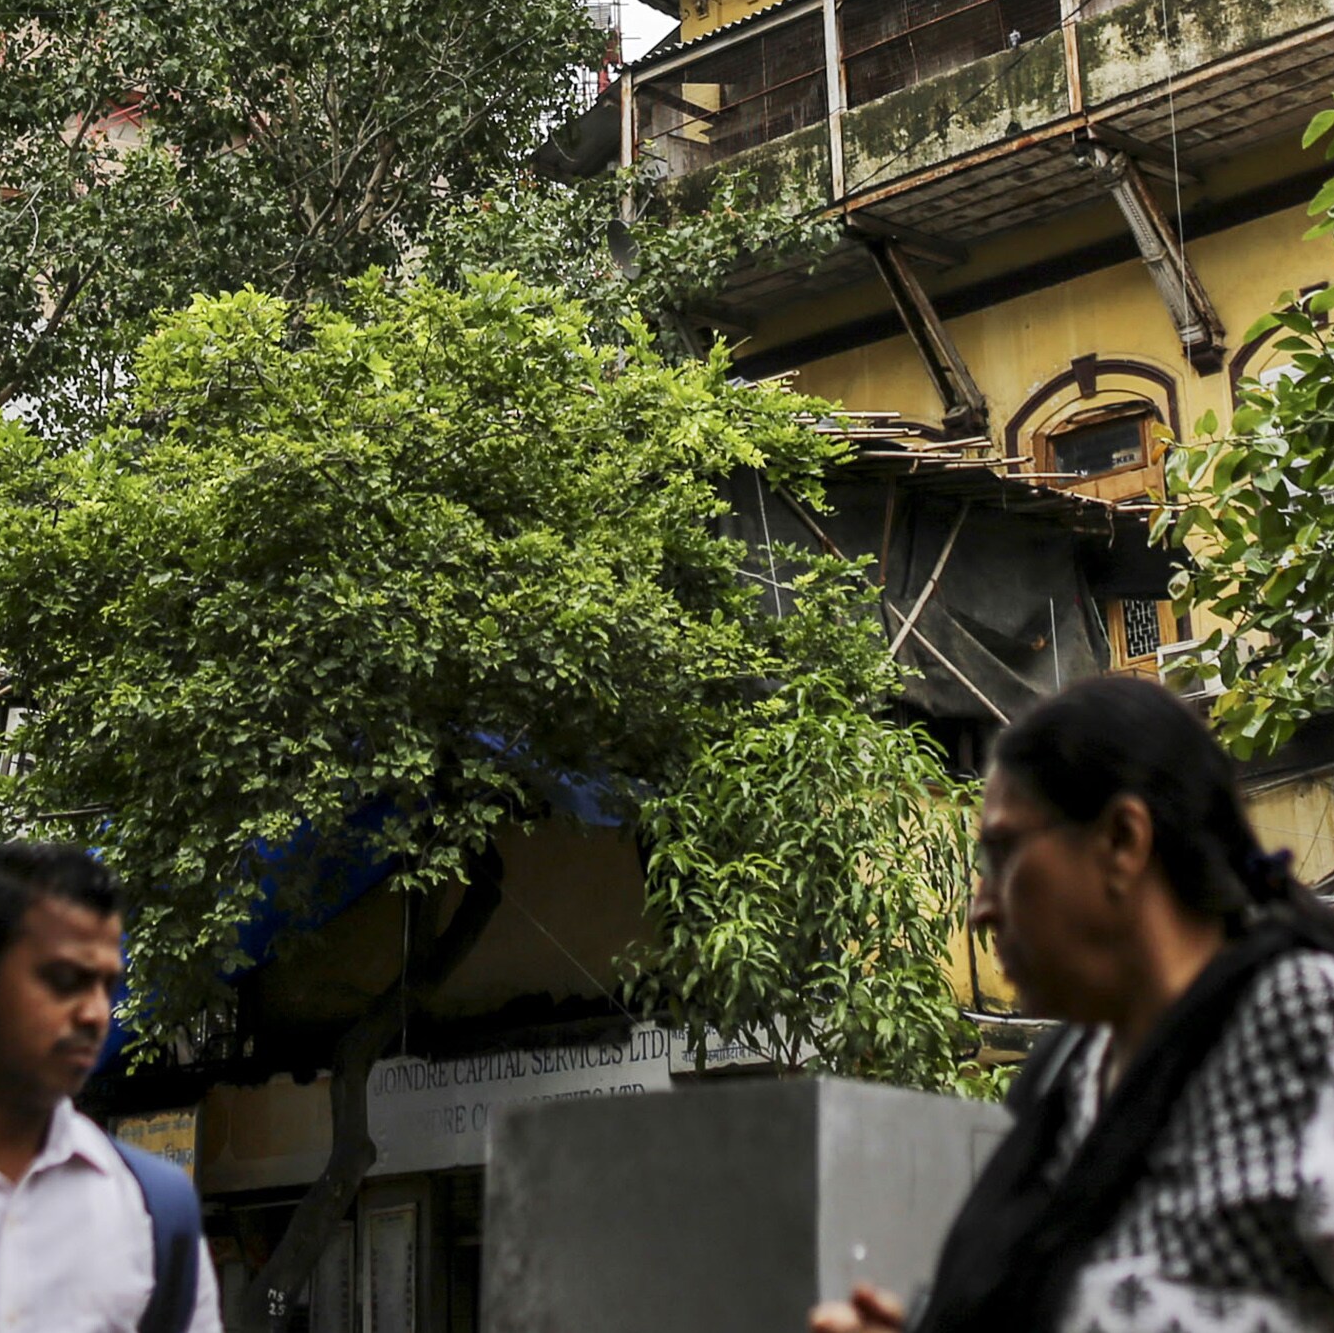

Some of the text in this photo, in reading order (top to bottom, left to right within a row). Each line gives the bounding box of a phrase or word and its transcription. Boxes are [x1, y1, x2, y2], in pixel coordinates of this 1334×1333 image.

[373, 1061, 449, 1097] JOINDRE
[454, 1050, 527, 1085] CAPITAL
[531, 1042, 624, 1076] SERVICES
[628, 1029, 670, 1062] LTD.
